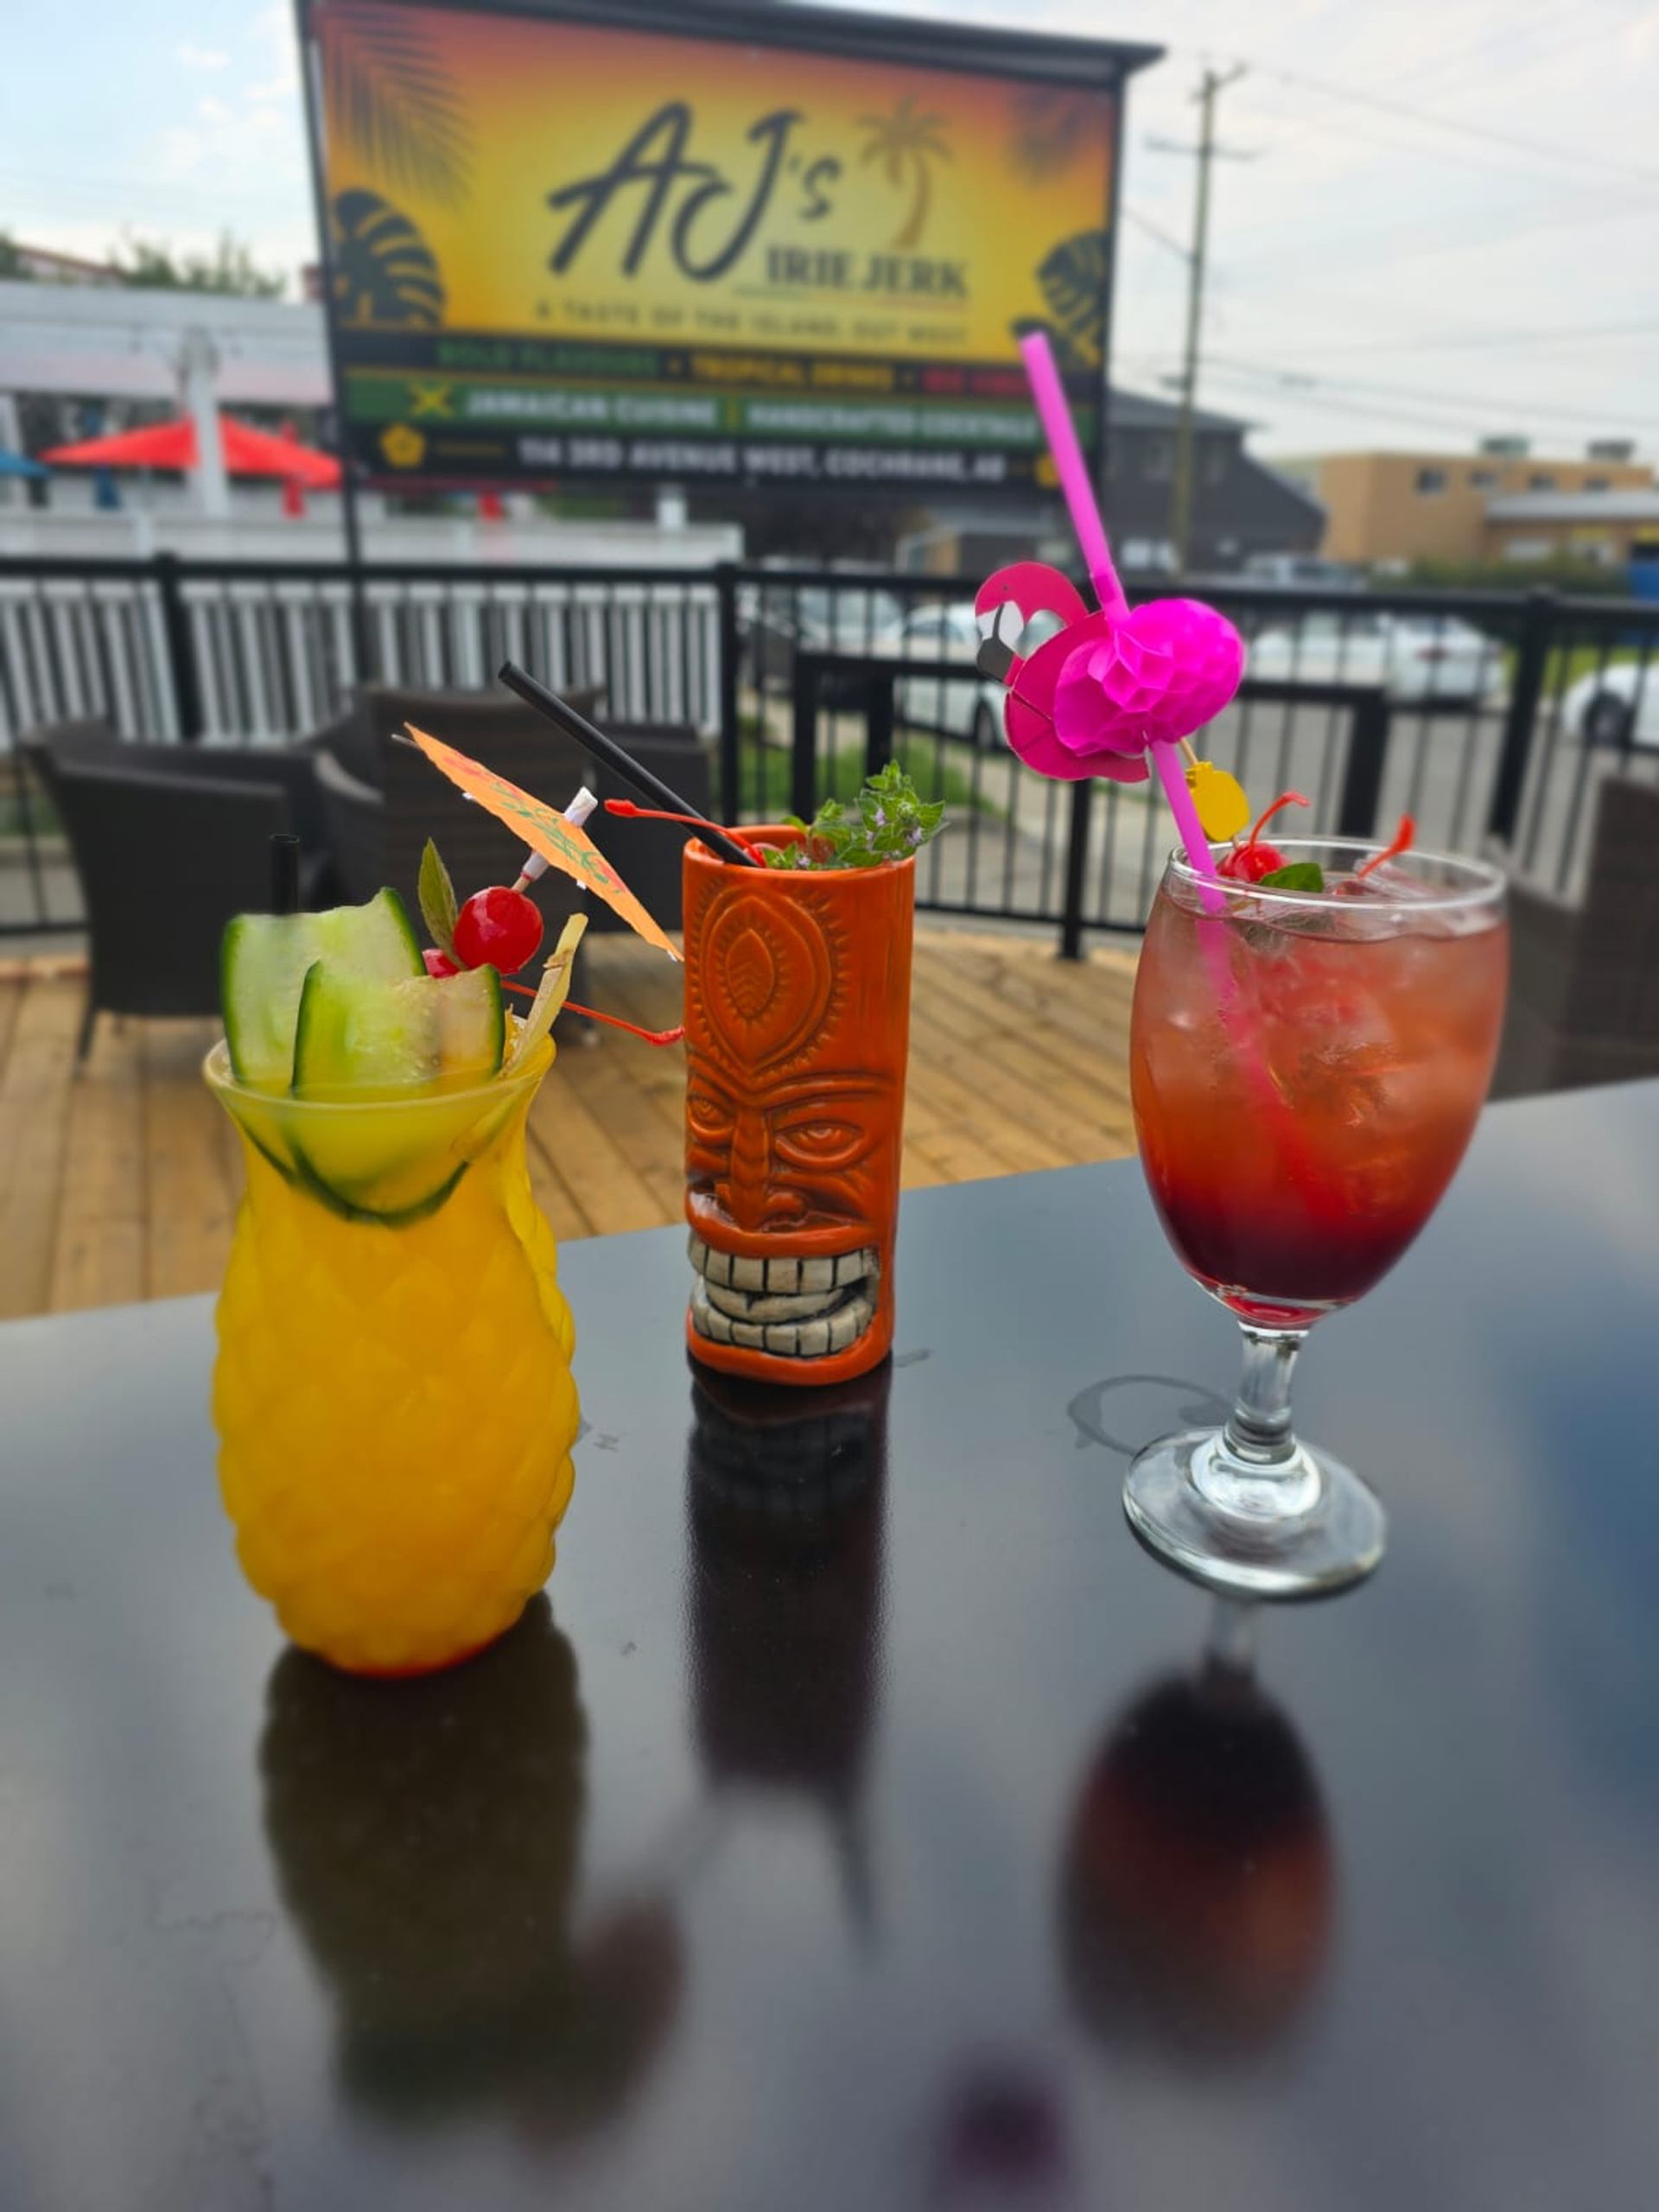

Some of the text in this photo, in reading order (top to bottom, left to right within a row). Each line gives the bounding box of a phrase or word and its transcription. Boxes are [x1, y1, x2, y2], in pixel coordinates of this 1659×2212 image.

[546, 100, 843, 283] AJ's
[766, 245, 969, 296] IRIE JERK
[562, 299, 639, 324] TASTE
[695, 306, 739, 330] THE
[467, 391, 607, 421] JAMAICAN
[616, 397, 716, 426] CUISINE
[569, 439, 623, 468] 3RD
[631, 442, 736, 473] AVENUE
